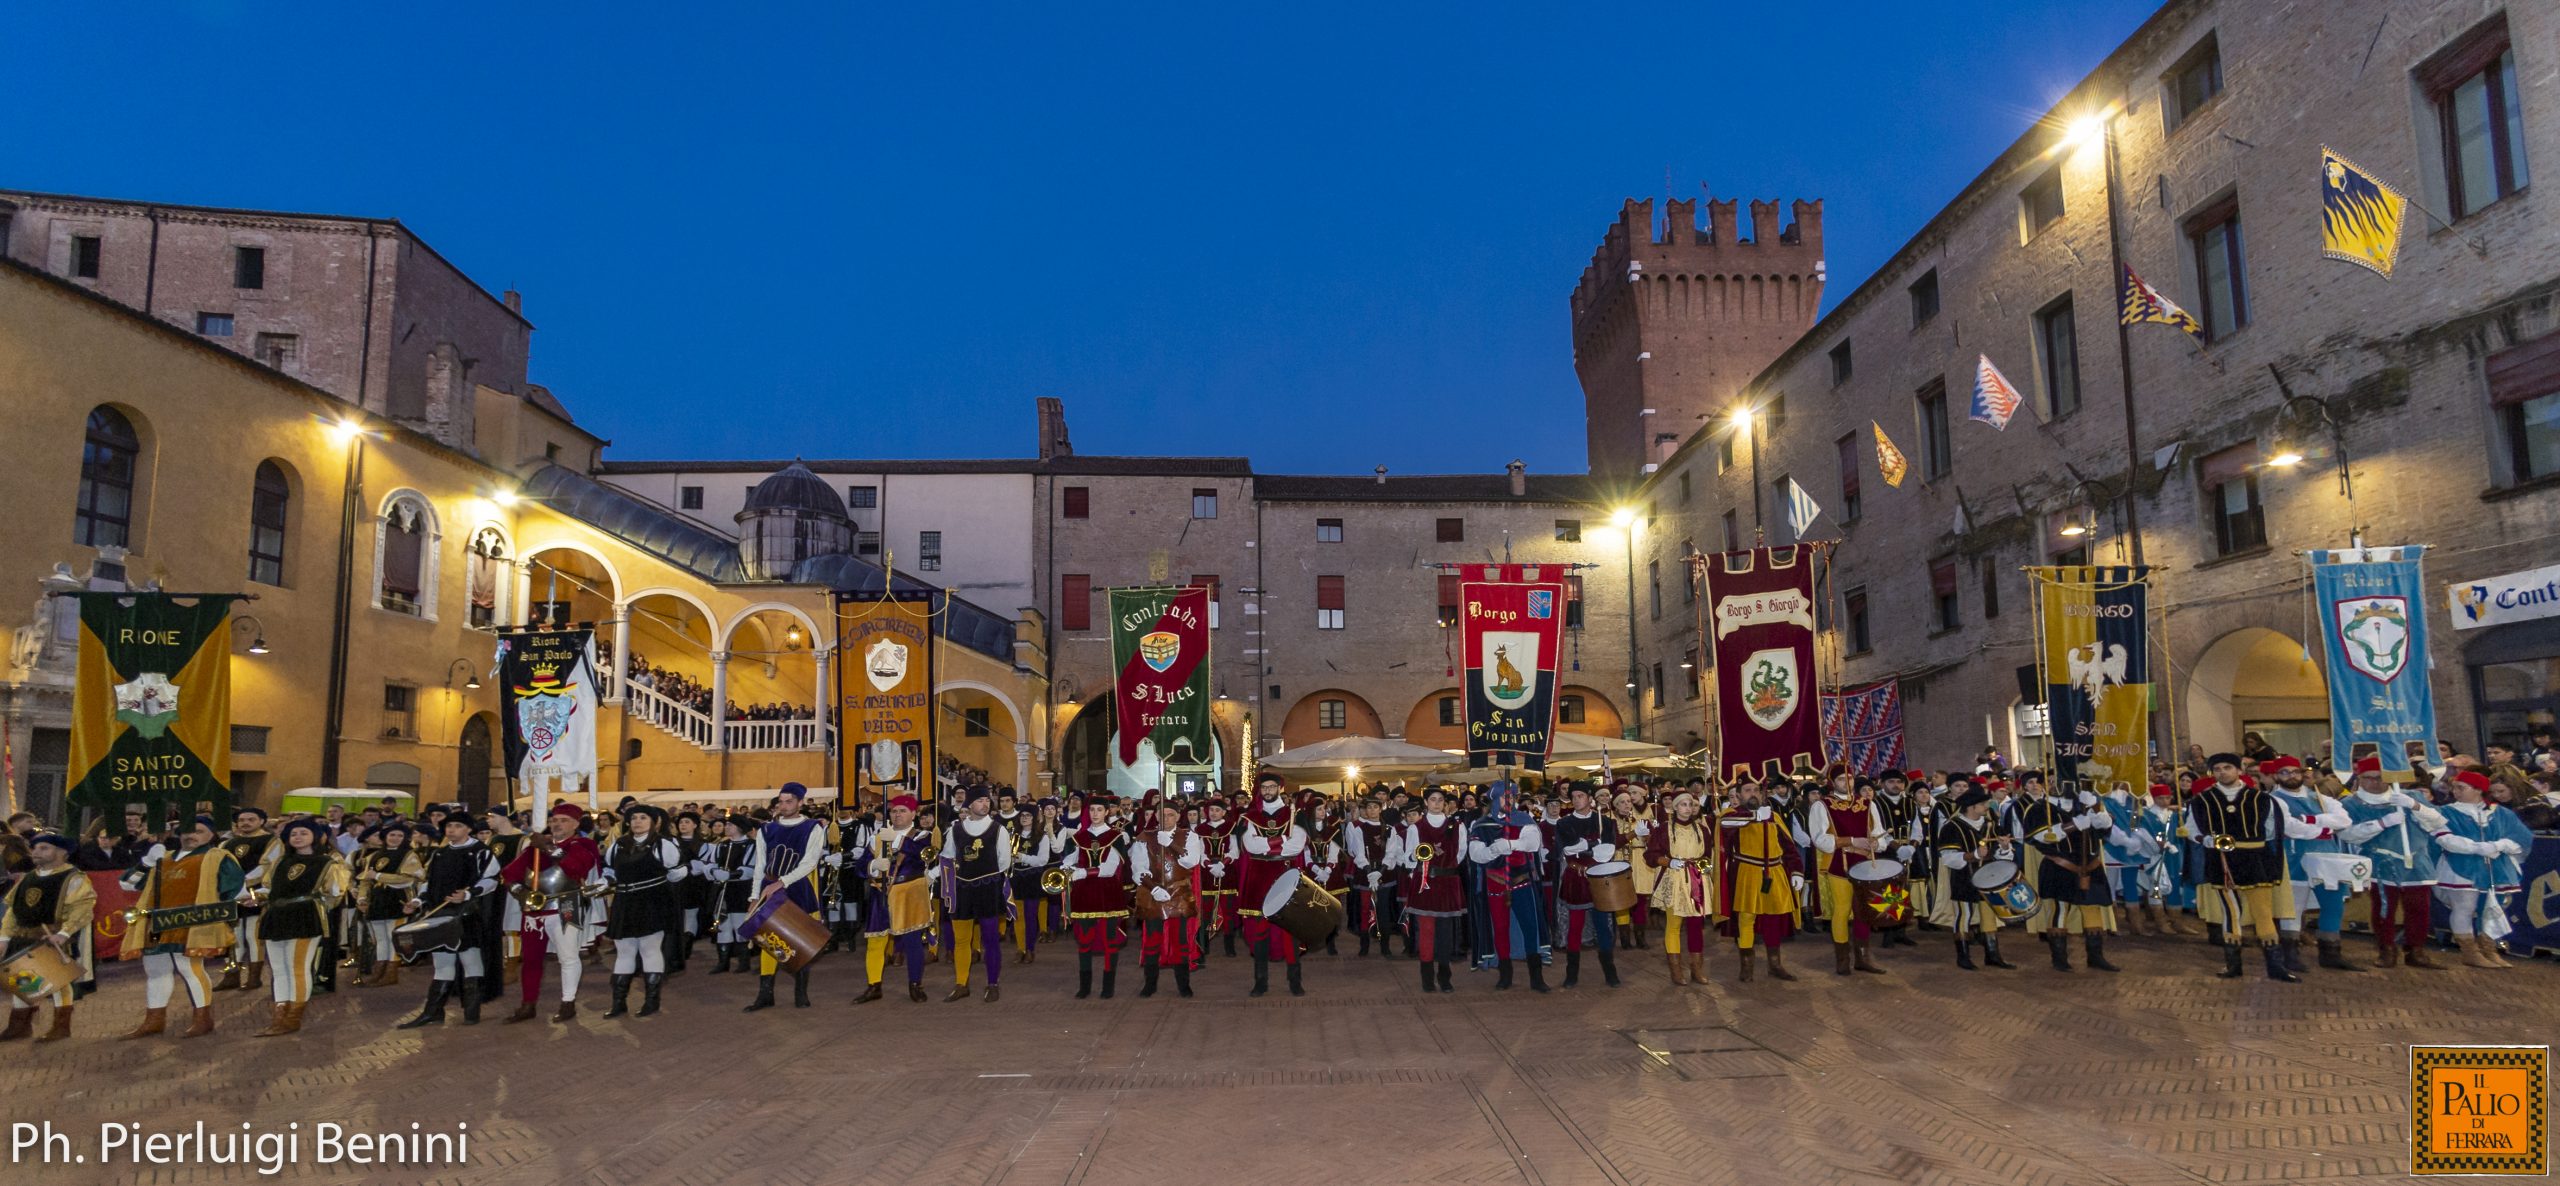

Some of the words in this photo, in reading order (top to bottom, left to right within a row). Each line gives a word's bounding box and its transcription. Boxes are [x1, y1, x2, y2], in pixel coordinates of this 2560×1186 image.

[2496, 580, 2560, 609] Cont
[1122, 599, 1198, 632] Contrada
[1469, 601, 1517, 624] Borgo
[1725, 604, 1752, 619] Borgo
[1768, 596, 1800, 613] Giorgio
[120, 628, 181, 646] RIONE
[531, 636, 560, 647] Rione
[520, 651, 539, 661] San
[544, 649, 573, 661] Paolo
[1152, 684, 1195, 704] Luca
[1141, 713, 1189, 726] Ferrara
[1490, 710, 1525, 728] San
[1472, 720, 1544, 744] Giovanni
[117, 755, 185, 772] SANTO
[112, 774, 193, 791] SPIRITO
